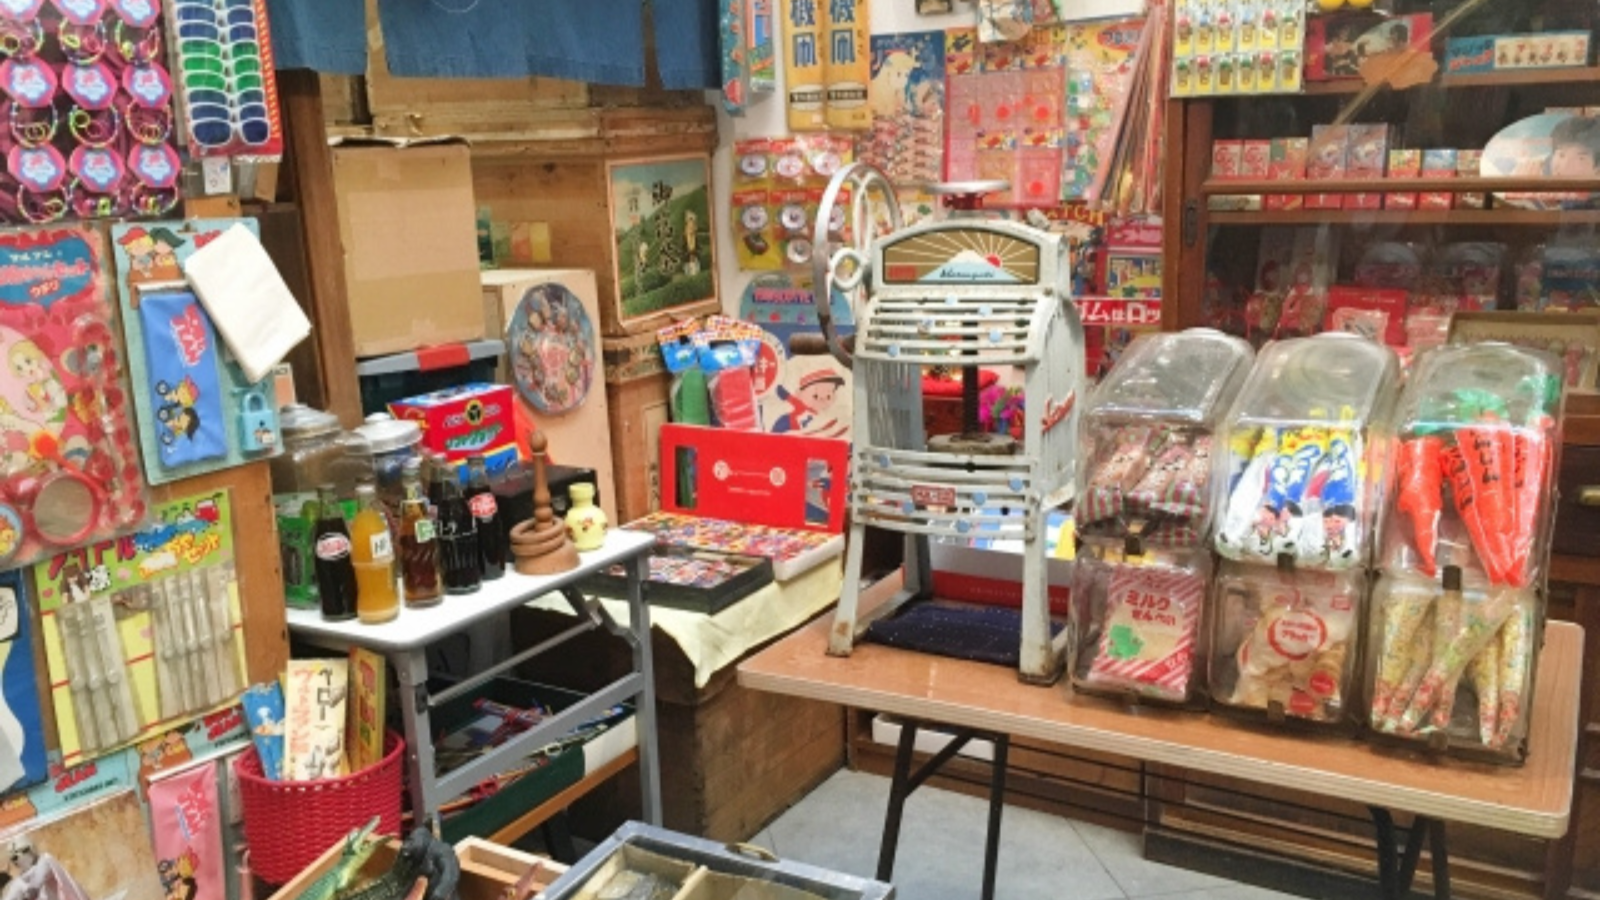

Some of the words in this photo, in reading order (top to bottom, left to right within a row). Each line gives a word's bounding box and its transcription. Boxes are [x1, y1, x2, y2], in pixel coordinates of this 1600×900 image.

[1046, 204, 1104, 226] ATCH
[1125, 589, 1171, 611] ミルク
